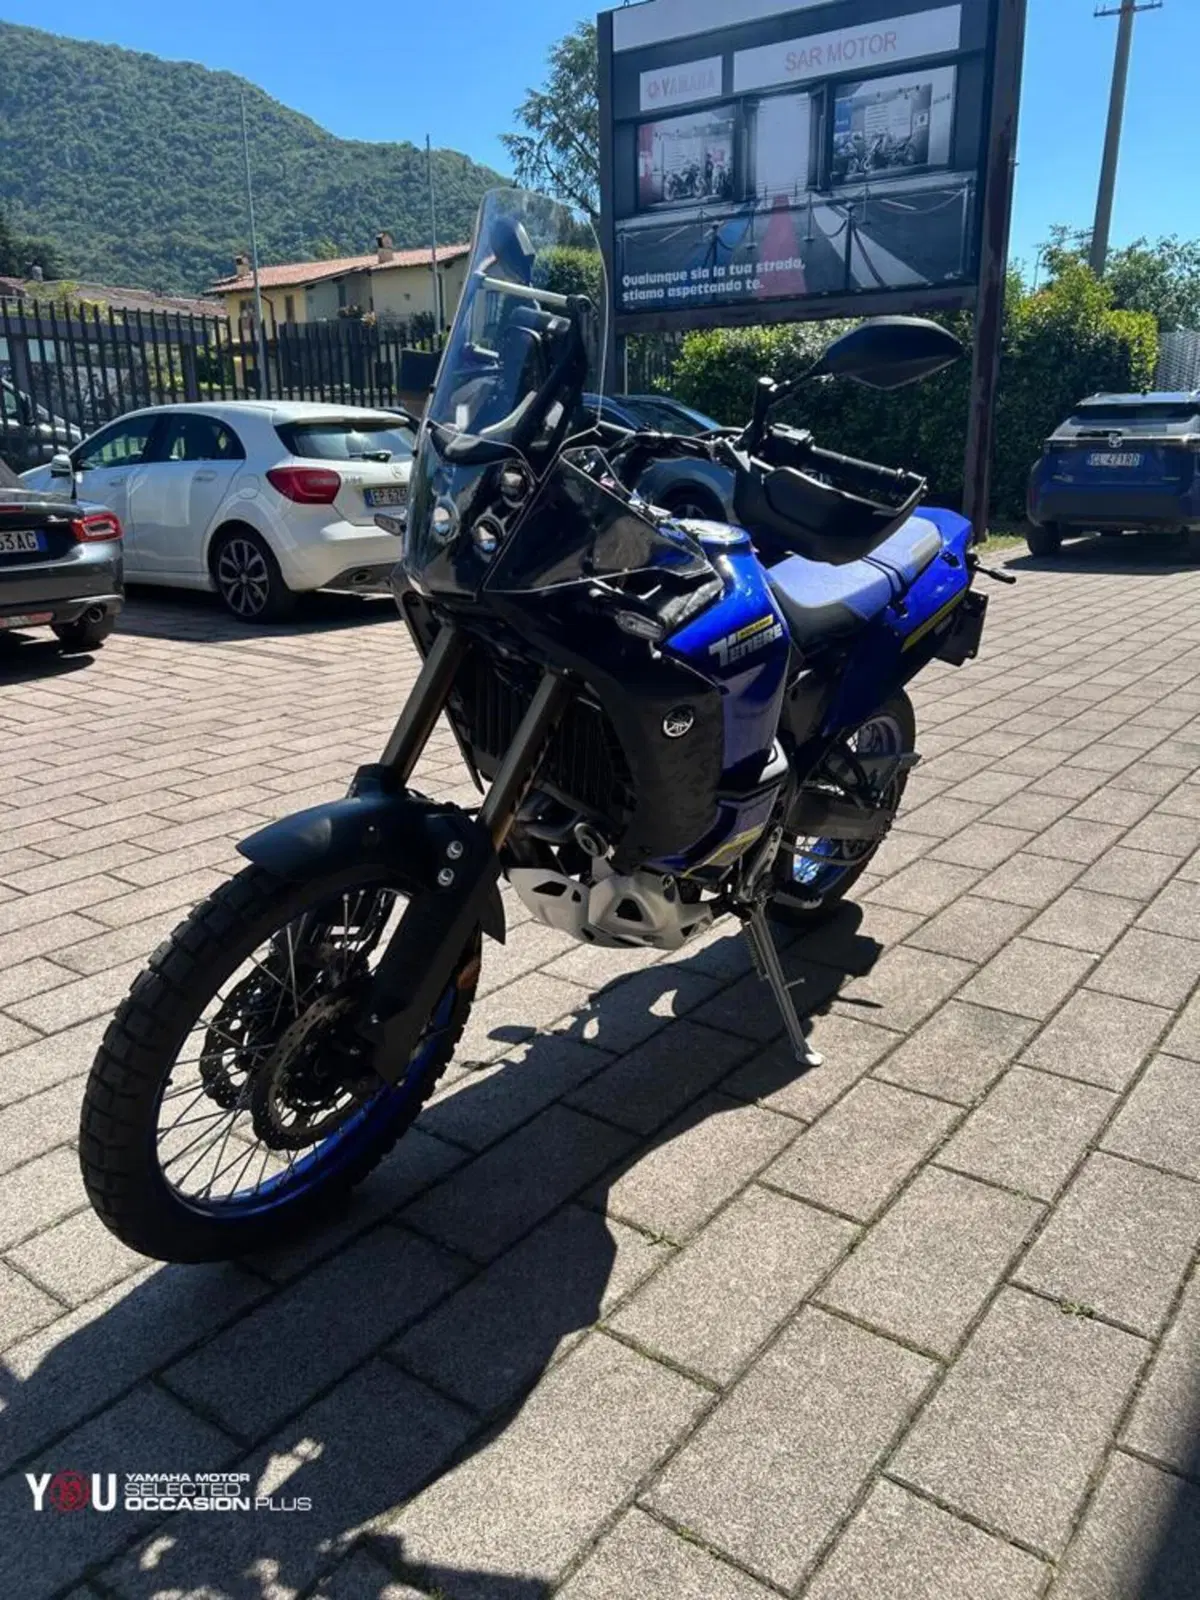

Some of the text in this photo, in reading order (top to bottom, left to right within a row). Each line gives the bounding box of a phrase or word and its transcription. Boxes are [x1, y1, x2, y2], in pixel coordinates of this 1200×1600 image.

[785, 31, 897, 71] SAR MOTOR
[622, 256, 806, 287] Qualunque sia la tua strada,
[622, 279, 765, 302] stiamo aspettando te.
